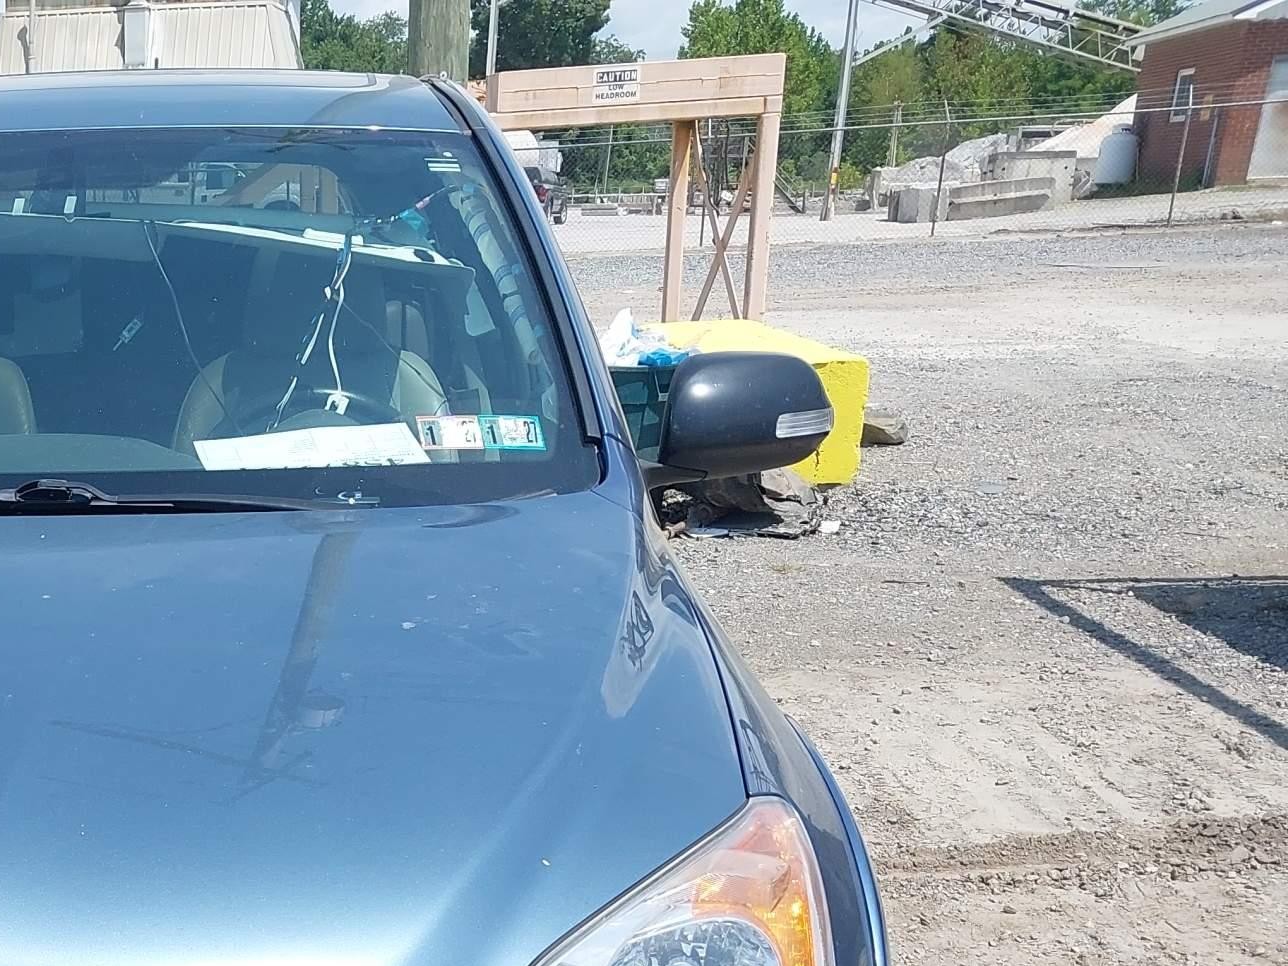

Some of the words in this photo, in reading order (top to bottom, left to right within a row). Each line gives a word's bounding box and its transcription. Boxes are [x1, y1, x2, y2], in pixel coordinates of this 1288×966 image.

[597, 70, 637, 82] CAUTION
[595, 91, 637, 100] HEADROOM
[426, 425, 437, 446] 1
[487, 424, 498, 445] 1
[523, 420, 538, 443] 27
